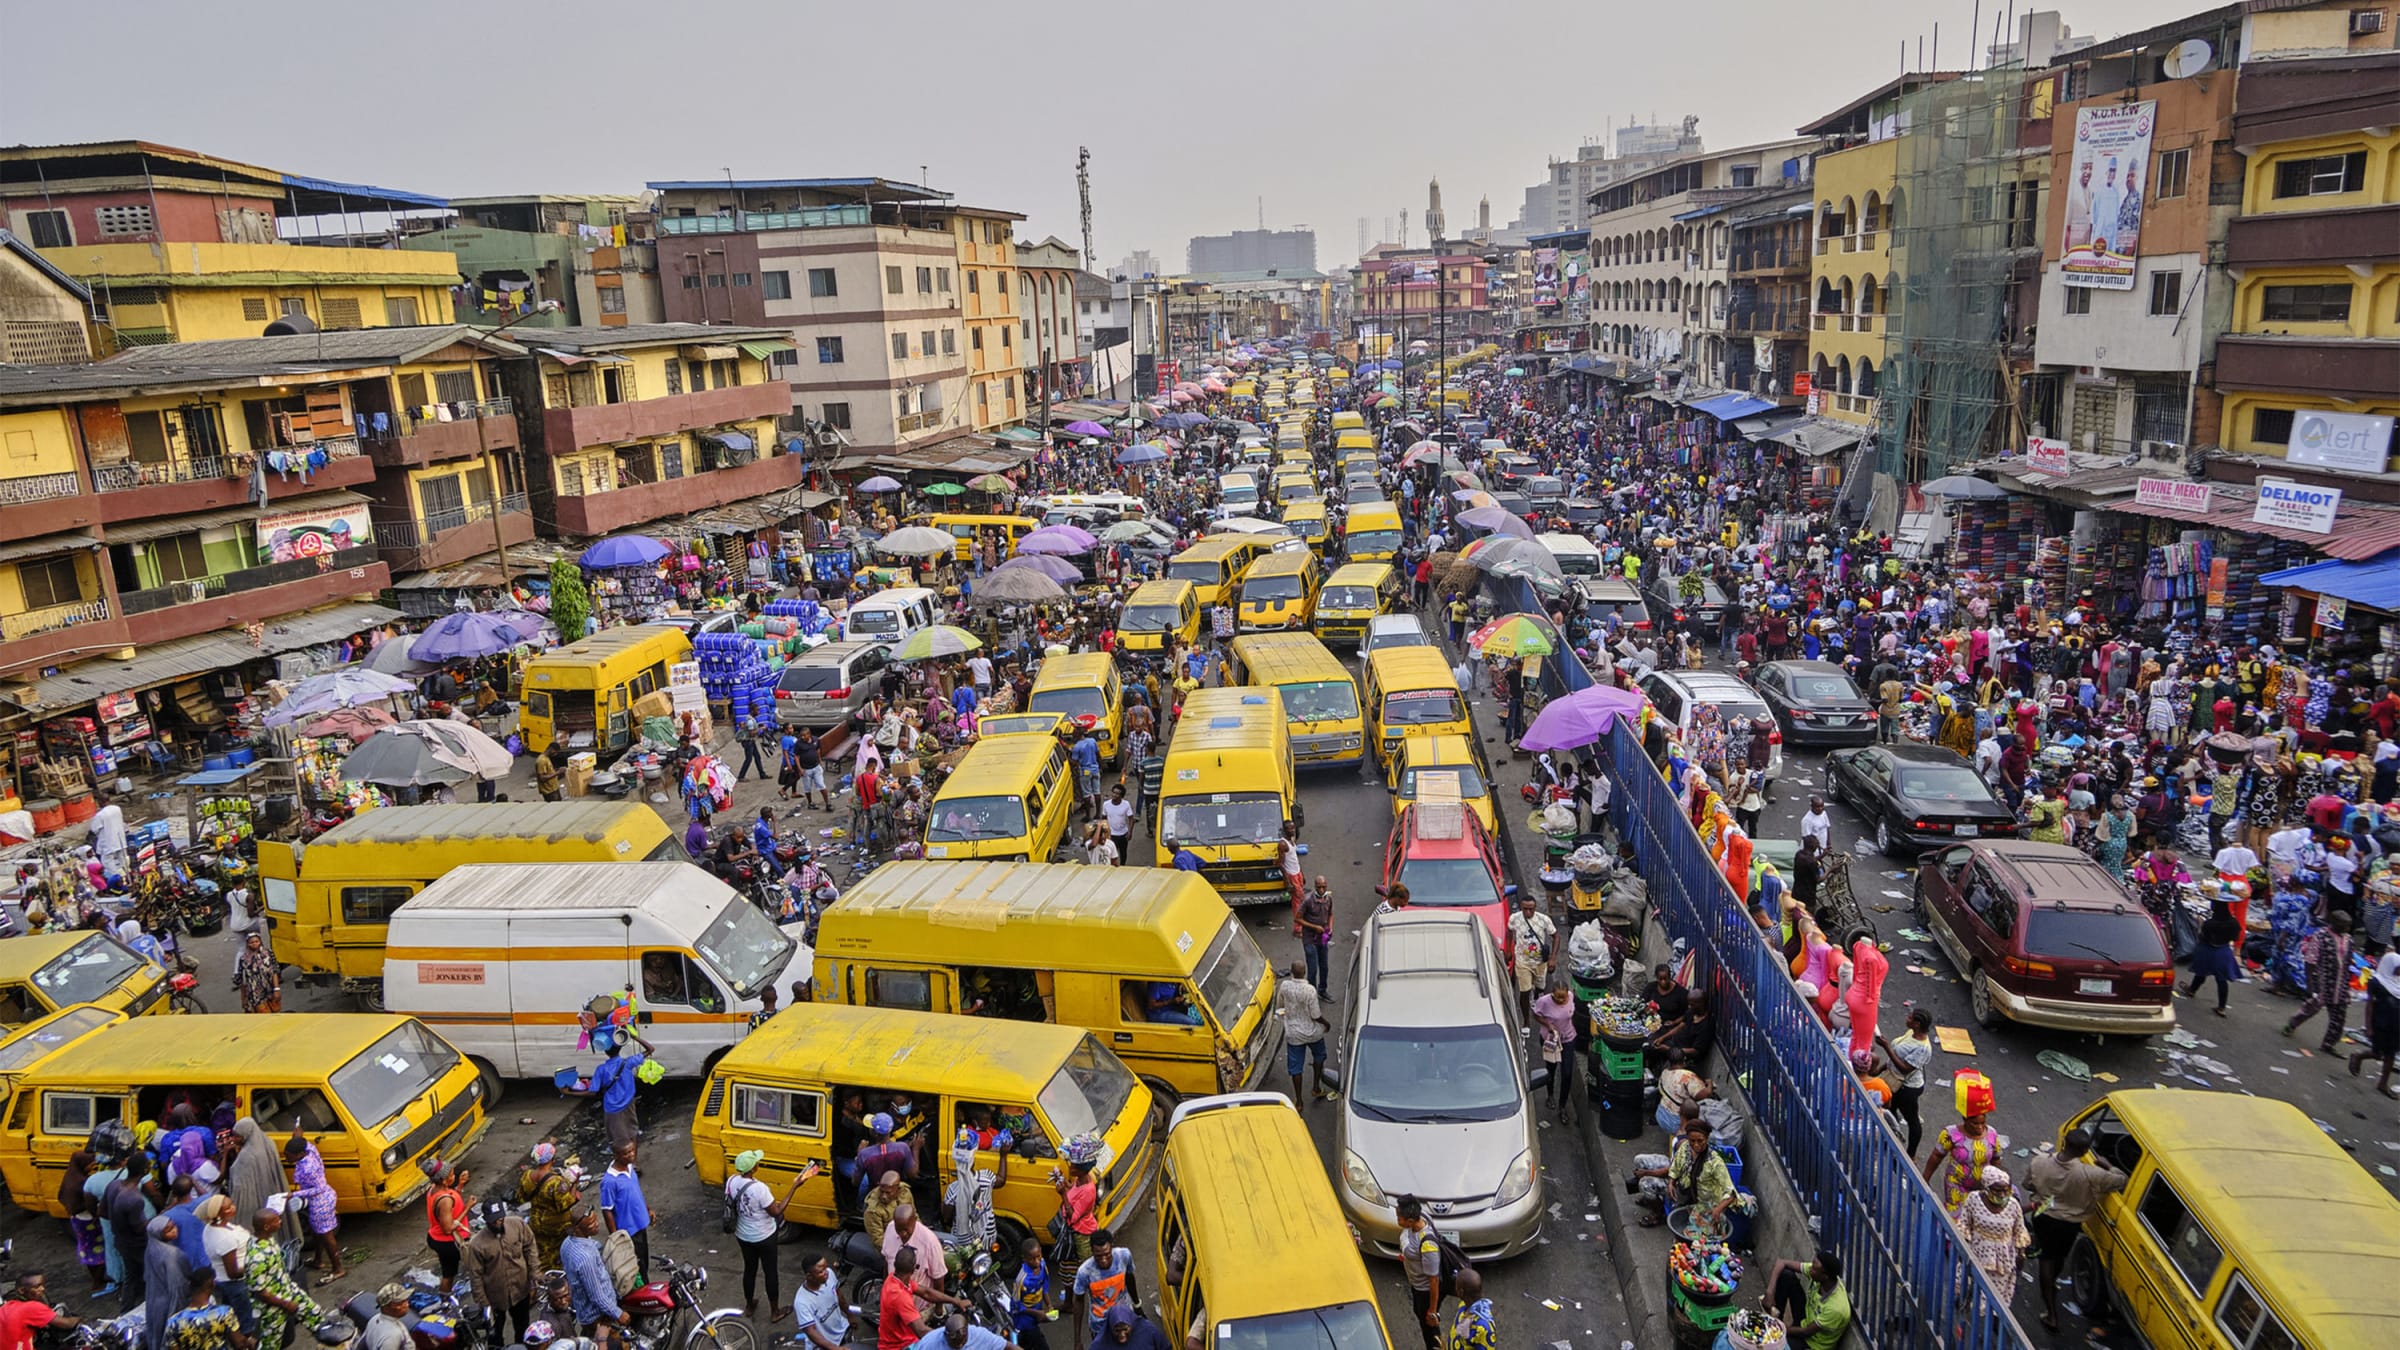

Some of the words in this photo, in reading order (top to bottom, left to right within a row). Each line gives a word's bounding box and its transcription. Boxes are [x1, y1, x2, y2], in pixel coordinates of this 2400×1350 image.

[2140, 479, 2172, 494] DIVINE
[2174, 483, 2208, 499] MERCY
[2261, 486, 2333, 507] DELMOT
[2275, 501, 2312, 511] FABRICS
[350, 568, 365, 579] 158
